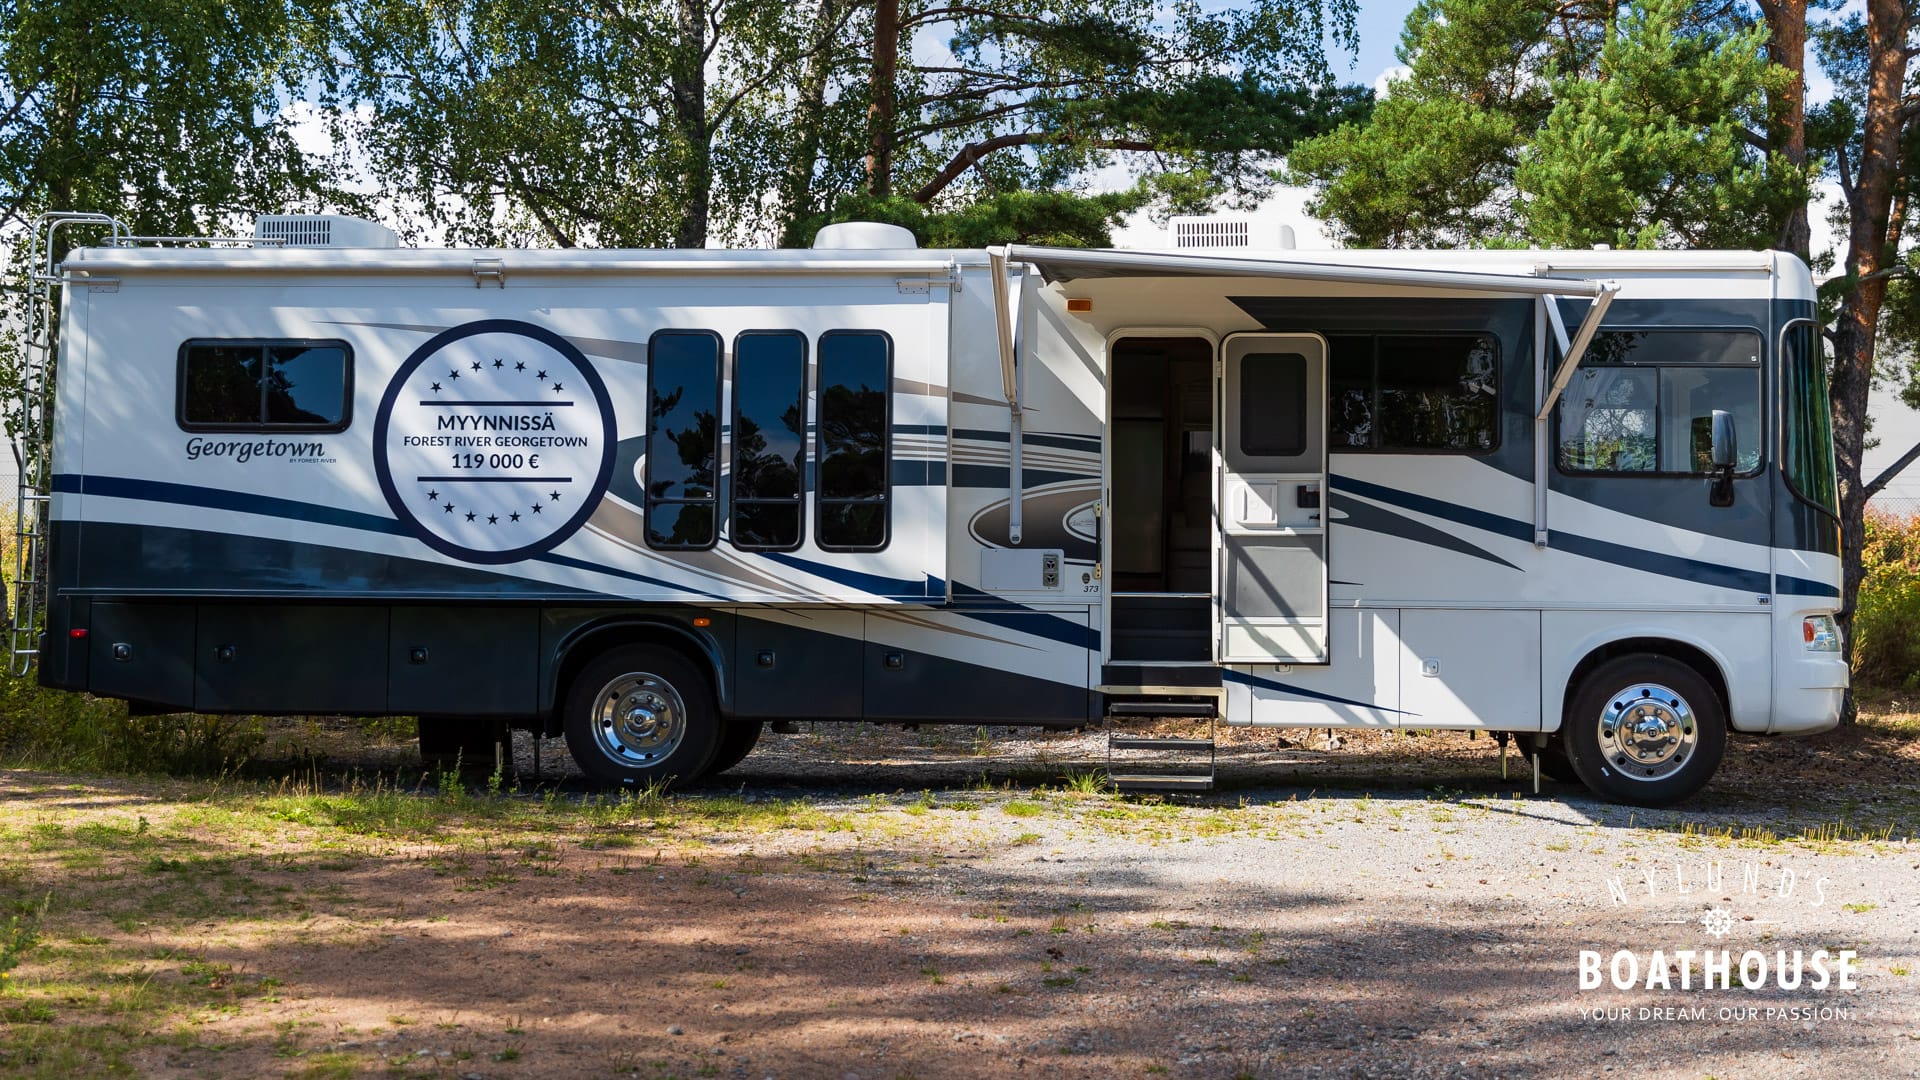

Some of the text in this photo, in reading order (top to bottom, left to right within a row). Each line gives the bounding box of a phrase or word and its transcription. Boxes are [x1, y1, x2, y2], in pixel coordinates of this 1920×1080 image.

[437, 412, 556, 431] MYYNNISSÄ
[403, 436, 588, 447] FOREST RIVER GEORGETOWN
[186, 437, 326, 464] Georgetown
[452, 453, 540, 469] 119 000 €
[1083, 585, 1099, 593] 373
